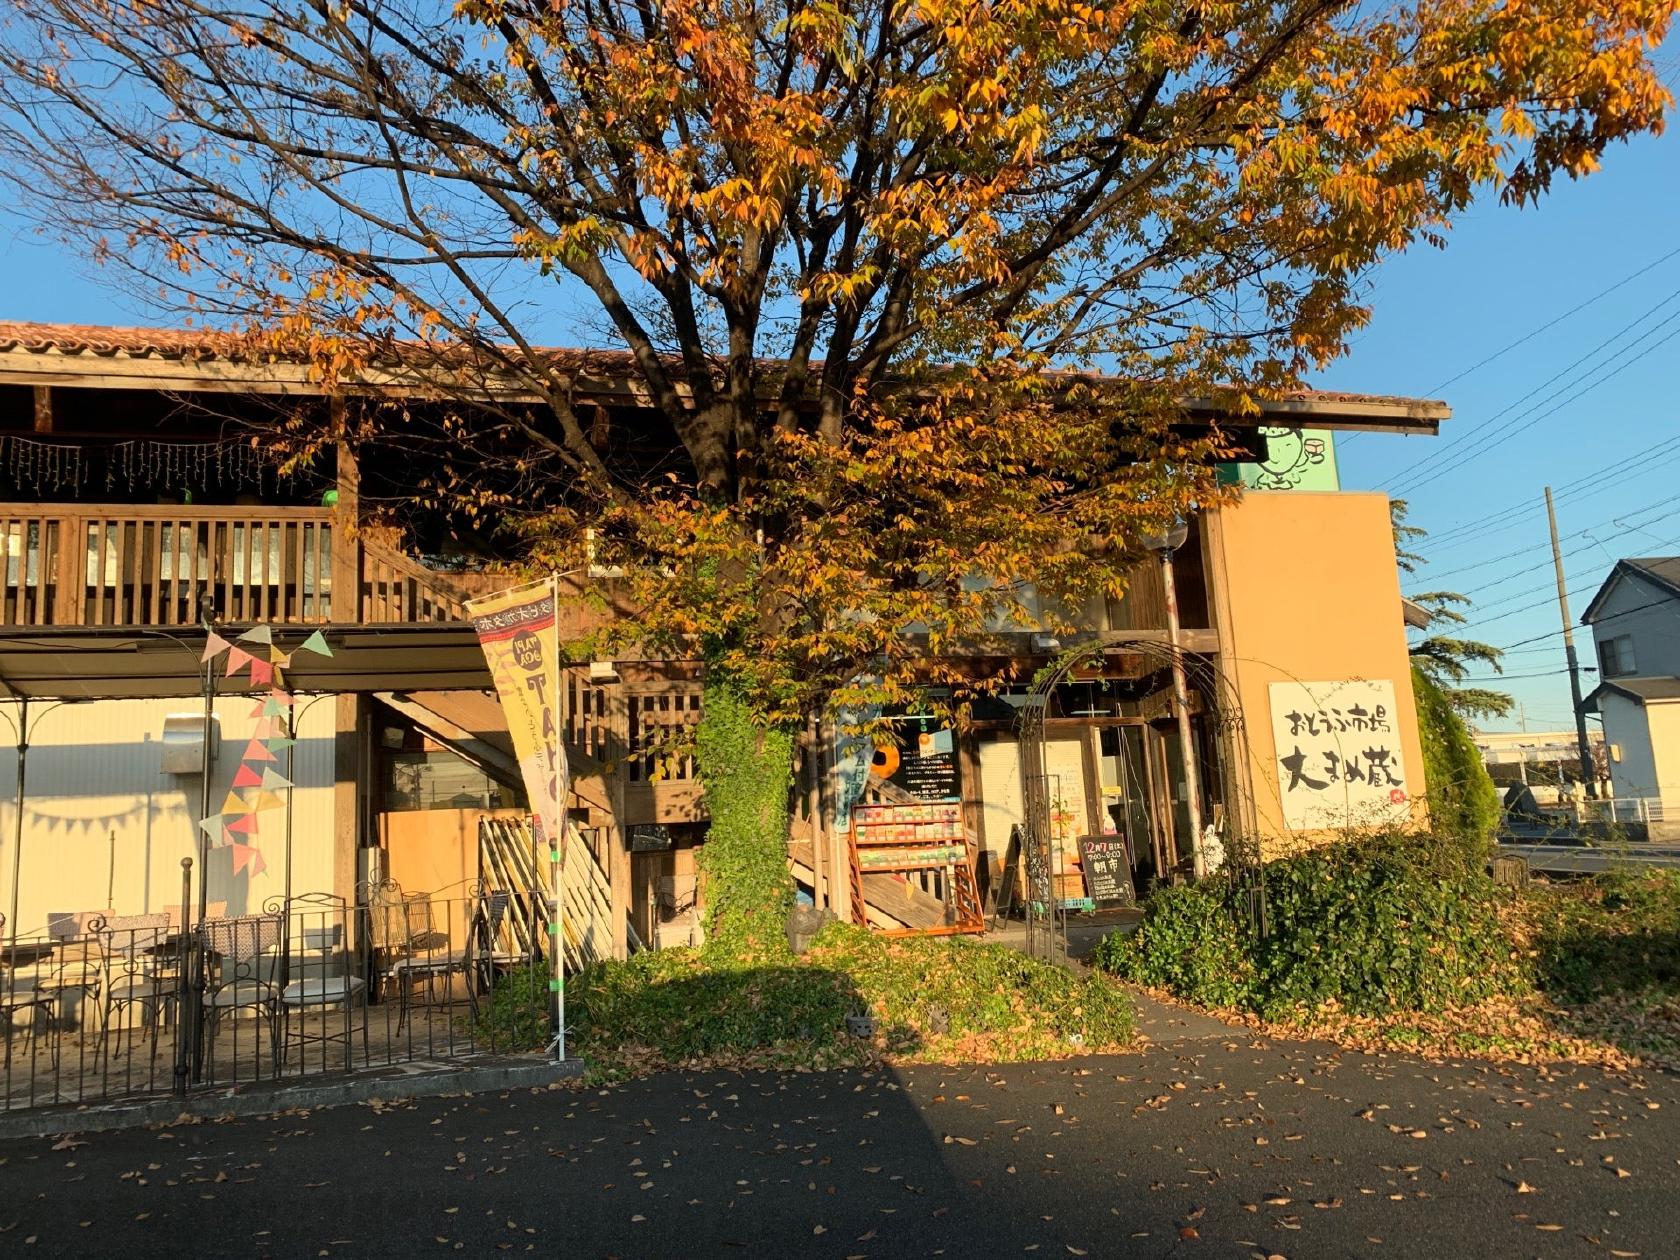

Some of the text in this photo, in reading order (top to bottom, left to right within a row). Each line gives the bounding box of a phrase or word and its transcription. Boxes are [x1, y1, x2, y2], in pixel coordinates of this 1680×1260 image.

[1284, 703, 1391, 736] おとうふ市場
[1280, 744, 1404, 792] 大まめ蔵
[1093, 857, 1118, 874] 朝市
